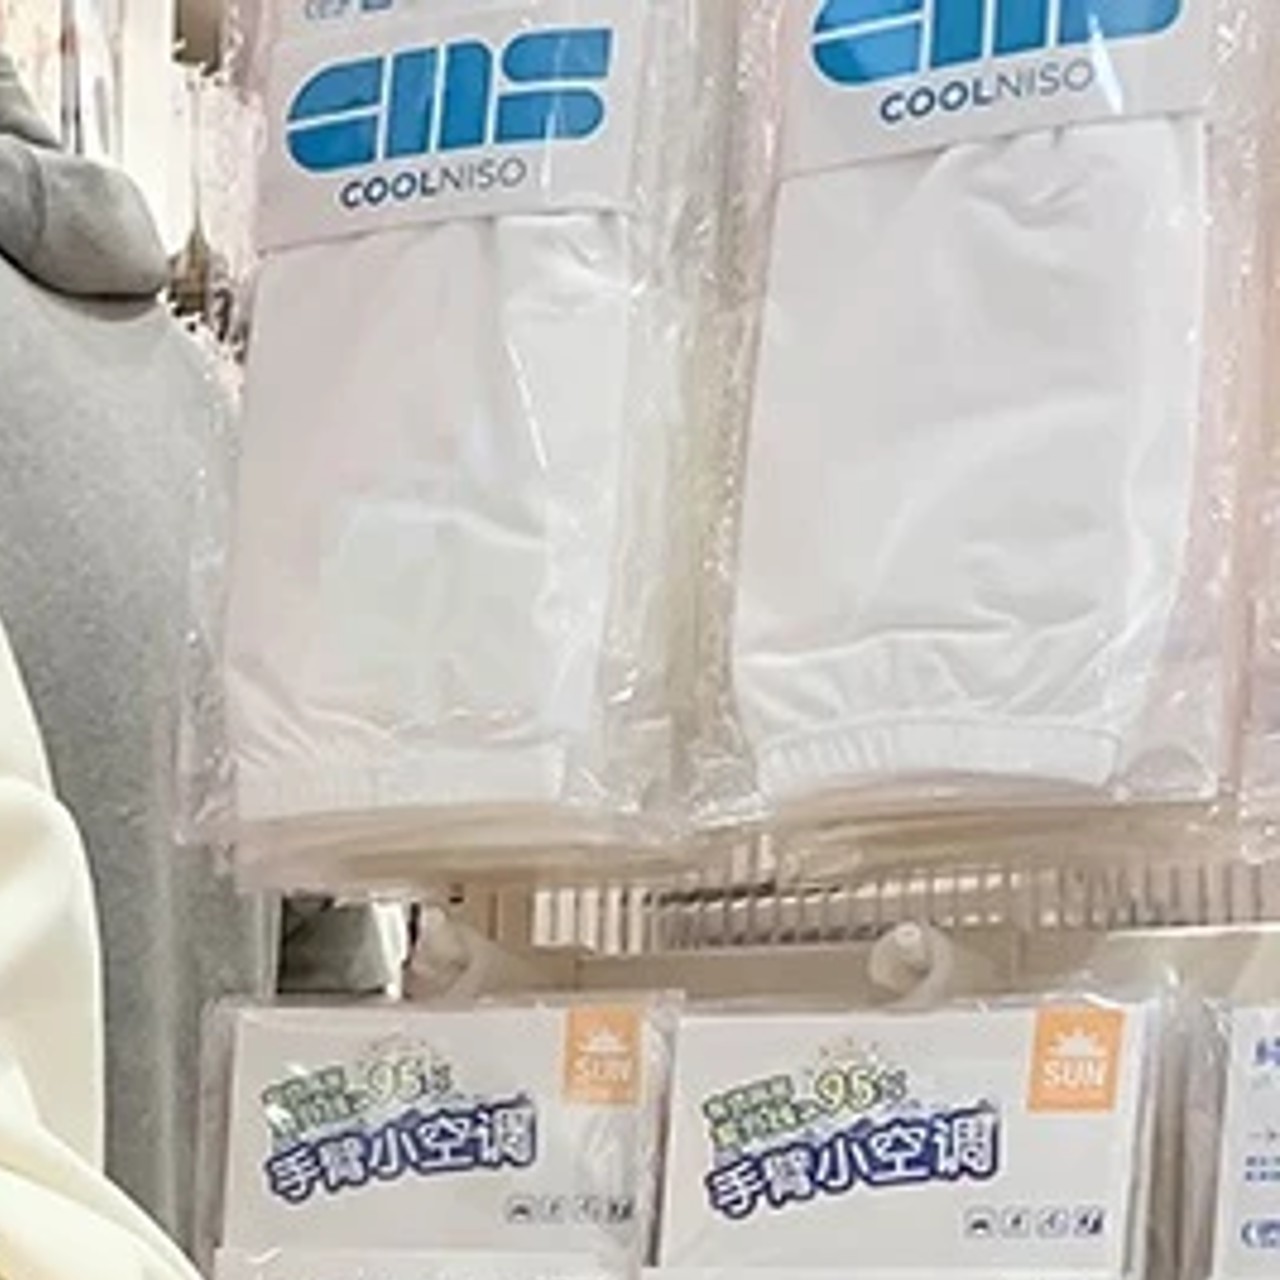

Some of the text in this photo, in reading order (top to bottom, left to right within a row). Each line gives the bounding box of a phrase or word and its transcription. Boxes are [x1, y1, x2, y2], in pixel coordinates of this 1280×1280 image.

[880, 60, 1095, 122] COOLNISO
[341, 156, 527, 208] COOLNISO
[574, 1054, 632, 1082] SUN
[1042, 1060, 1107, 1088] SUN
[268, 1098, 536, 1204] 手臂小空调
[706, 1104, 998, 1218] 手臂小空调
